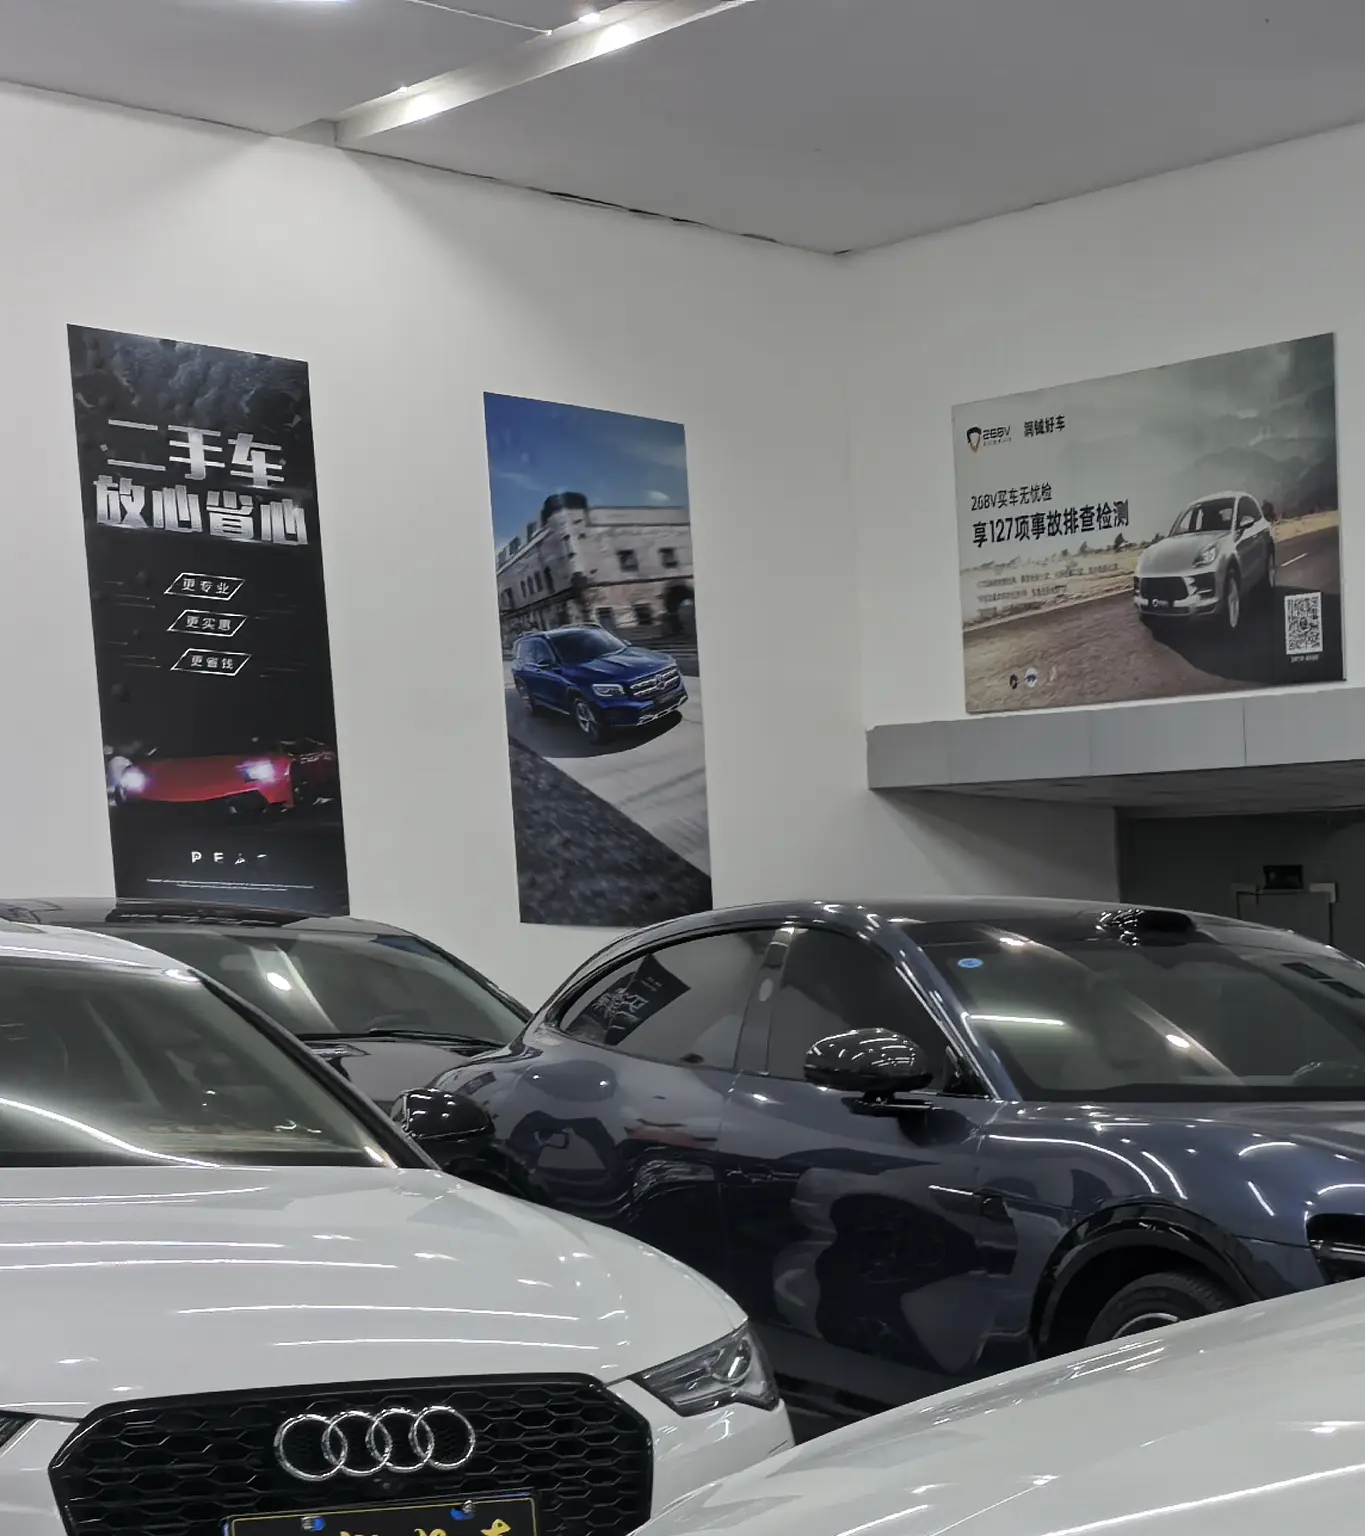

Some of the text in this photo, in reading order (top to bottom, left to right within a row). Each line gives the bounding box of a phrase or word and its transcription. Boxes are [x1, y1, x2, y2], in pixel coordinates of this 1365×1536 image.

[107, 418, 285, 488] 二手车
[93, 474, 309, 546] 放心省心
[972, 498, 1130, 549] 享127项事故排查检测
[181, 578, 230, 595] 更专业
[190, 654, 234, 670] 更省钱
